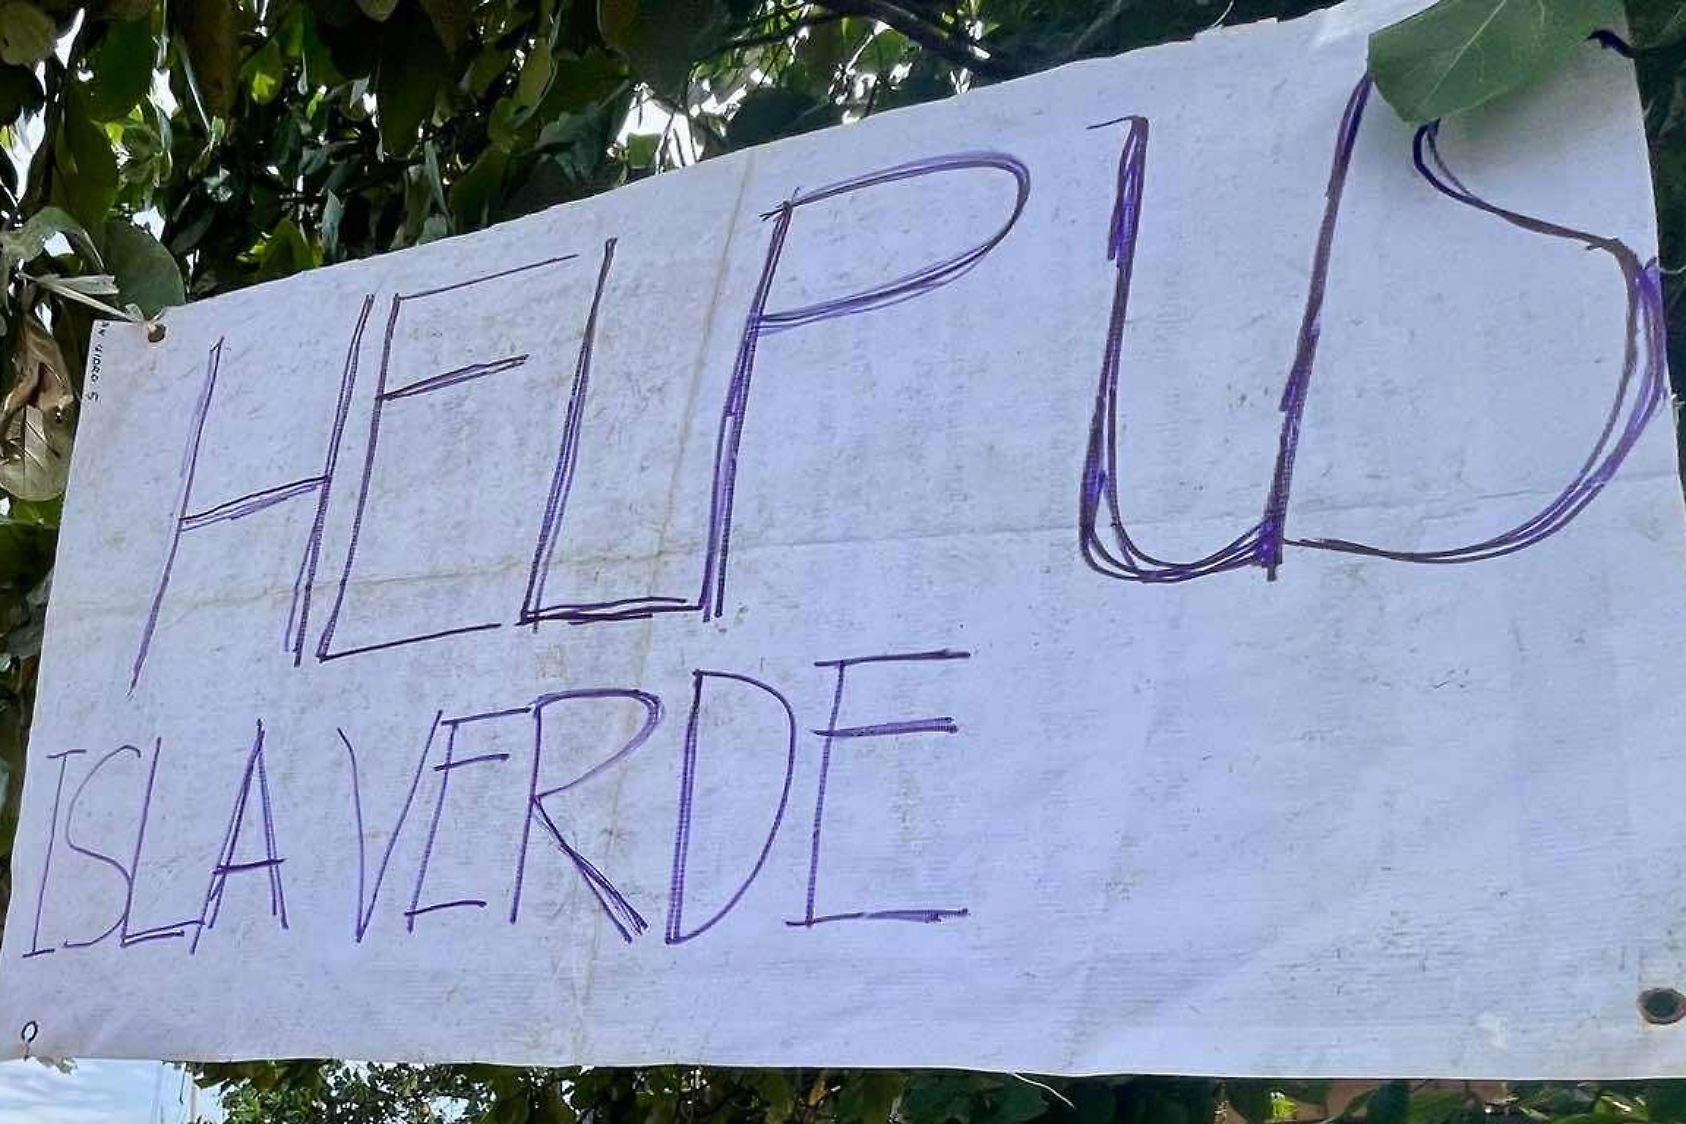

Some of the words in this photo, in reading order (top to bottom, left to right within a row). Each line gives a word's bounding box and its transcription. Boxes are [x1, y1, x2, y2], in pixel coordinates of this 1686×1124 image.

[127, 152, 1031, 698] HELP
[1079, 72, 1668, 583] US
[22, 719, 289, 956] ISLA
[336, 651, 972, 945] VERDE
